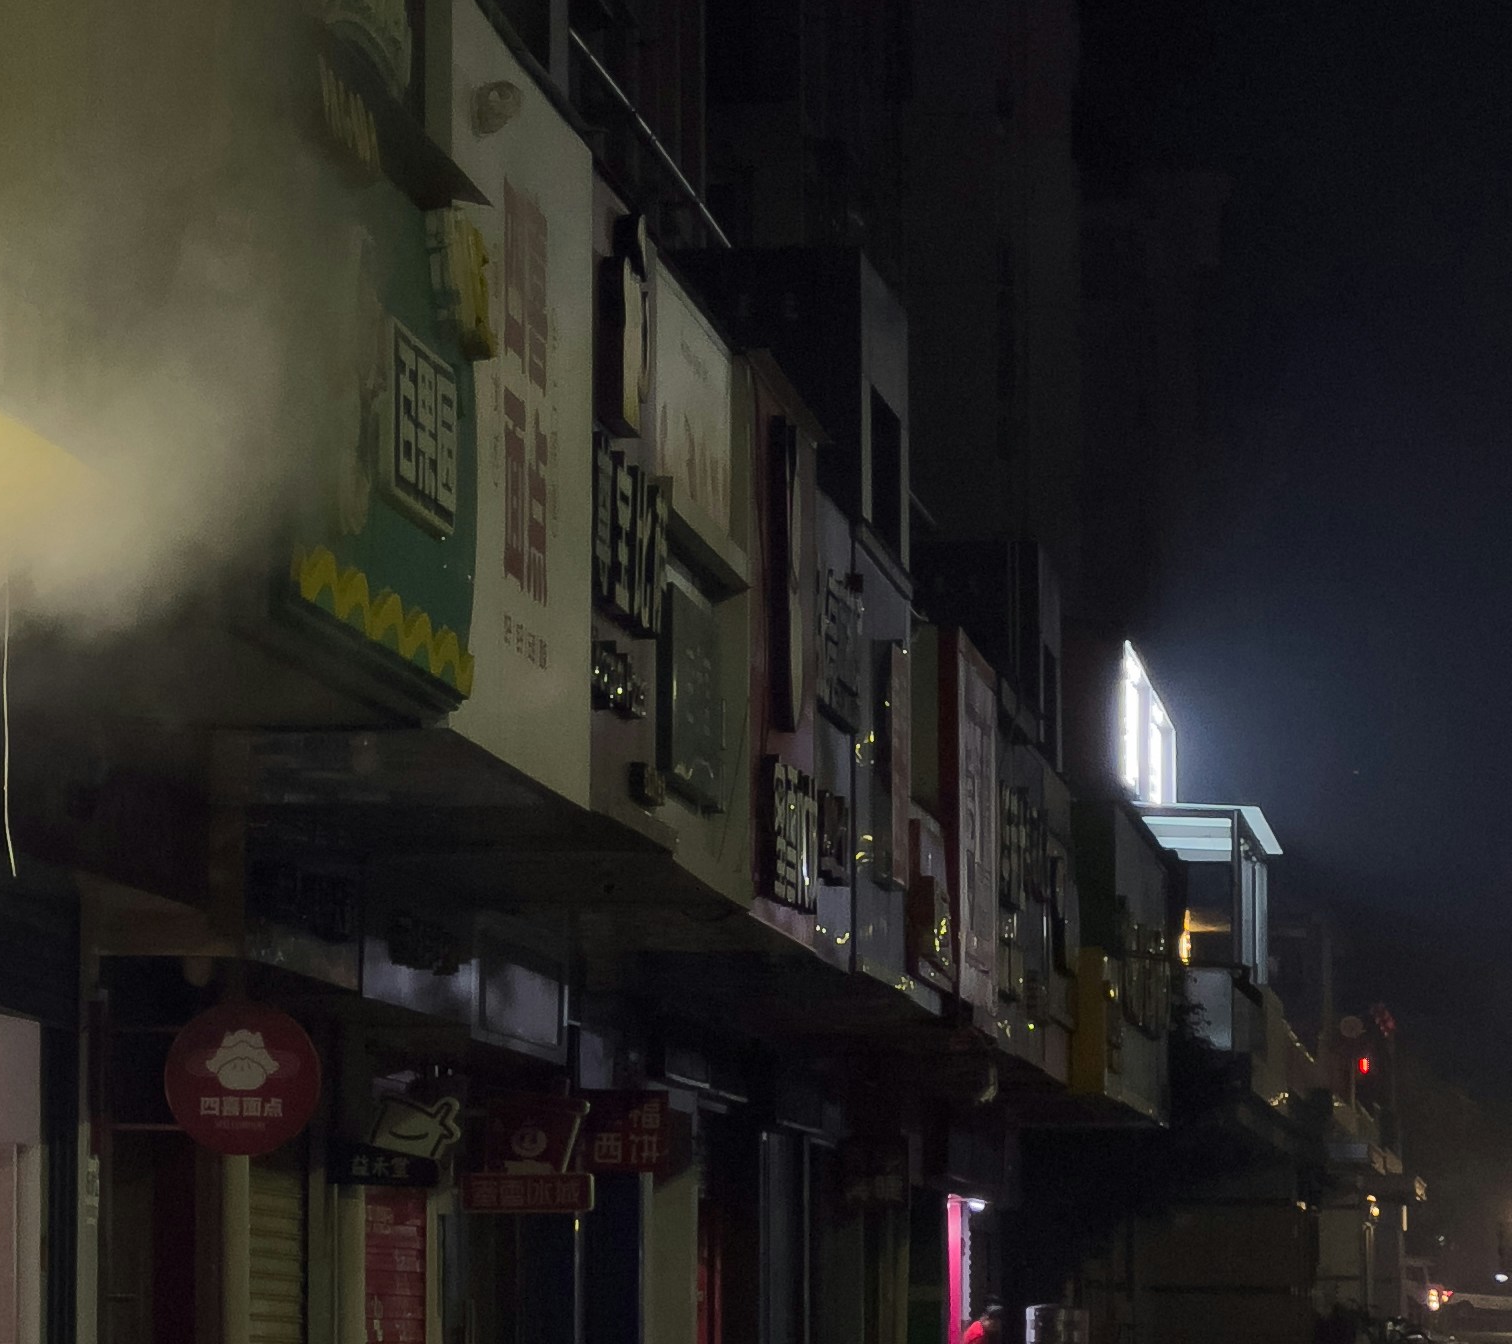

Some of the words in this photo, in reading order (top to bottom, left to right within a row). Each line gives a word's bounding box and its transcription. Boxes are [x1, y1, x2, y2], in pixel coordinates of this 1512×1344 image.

[503, 386, 549, 608] 面点
[199, 1096, 284, 1118] 四喜面点
[594, 1132, 660, 1164] 西饼
[351, 1156, 410, 1179] 益禾堂
[471, 1178, 582, 1206] 蜜雪冰城
